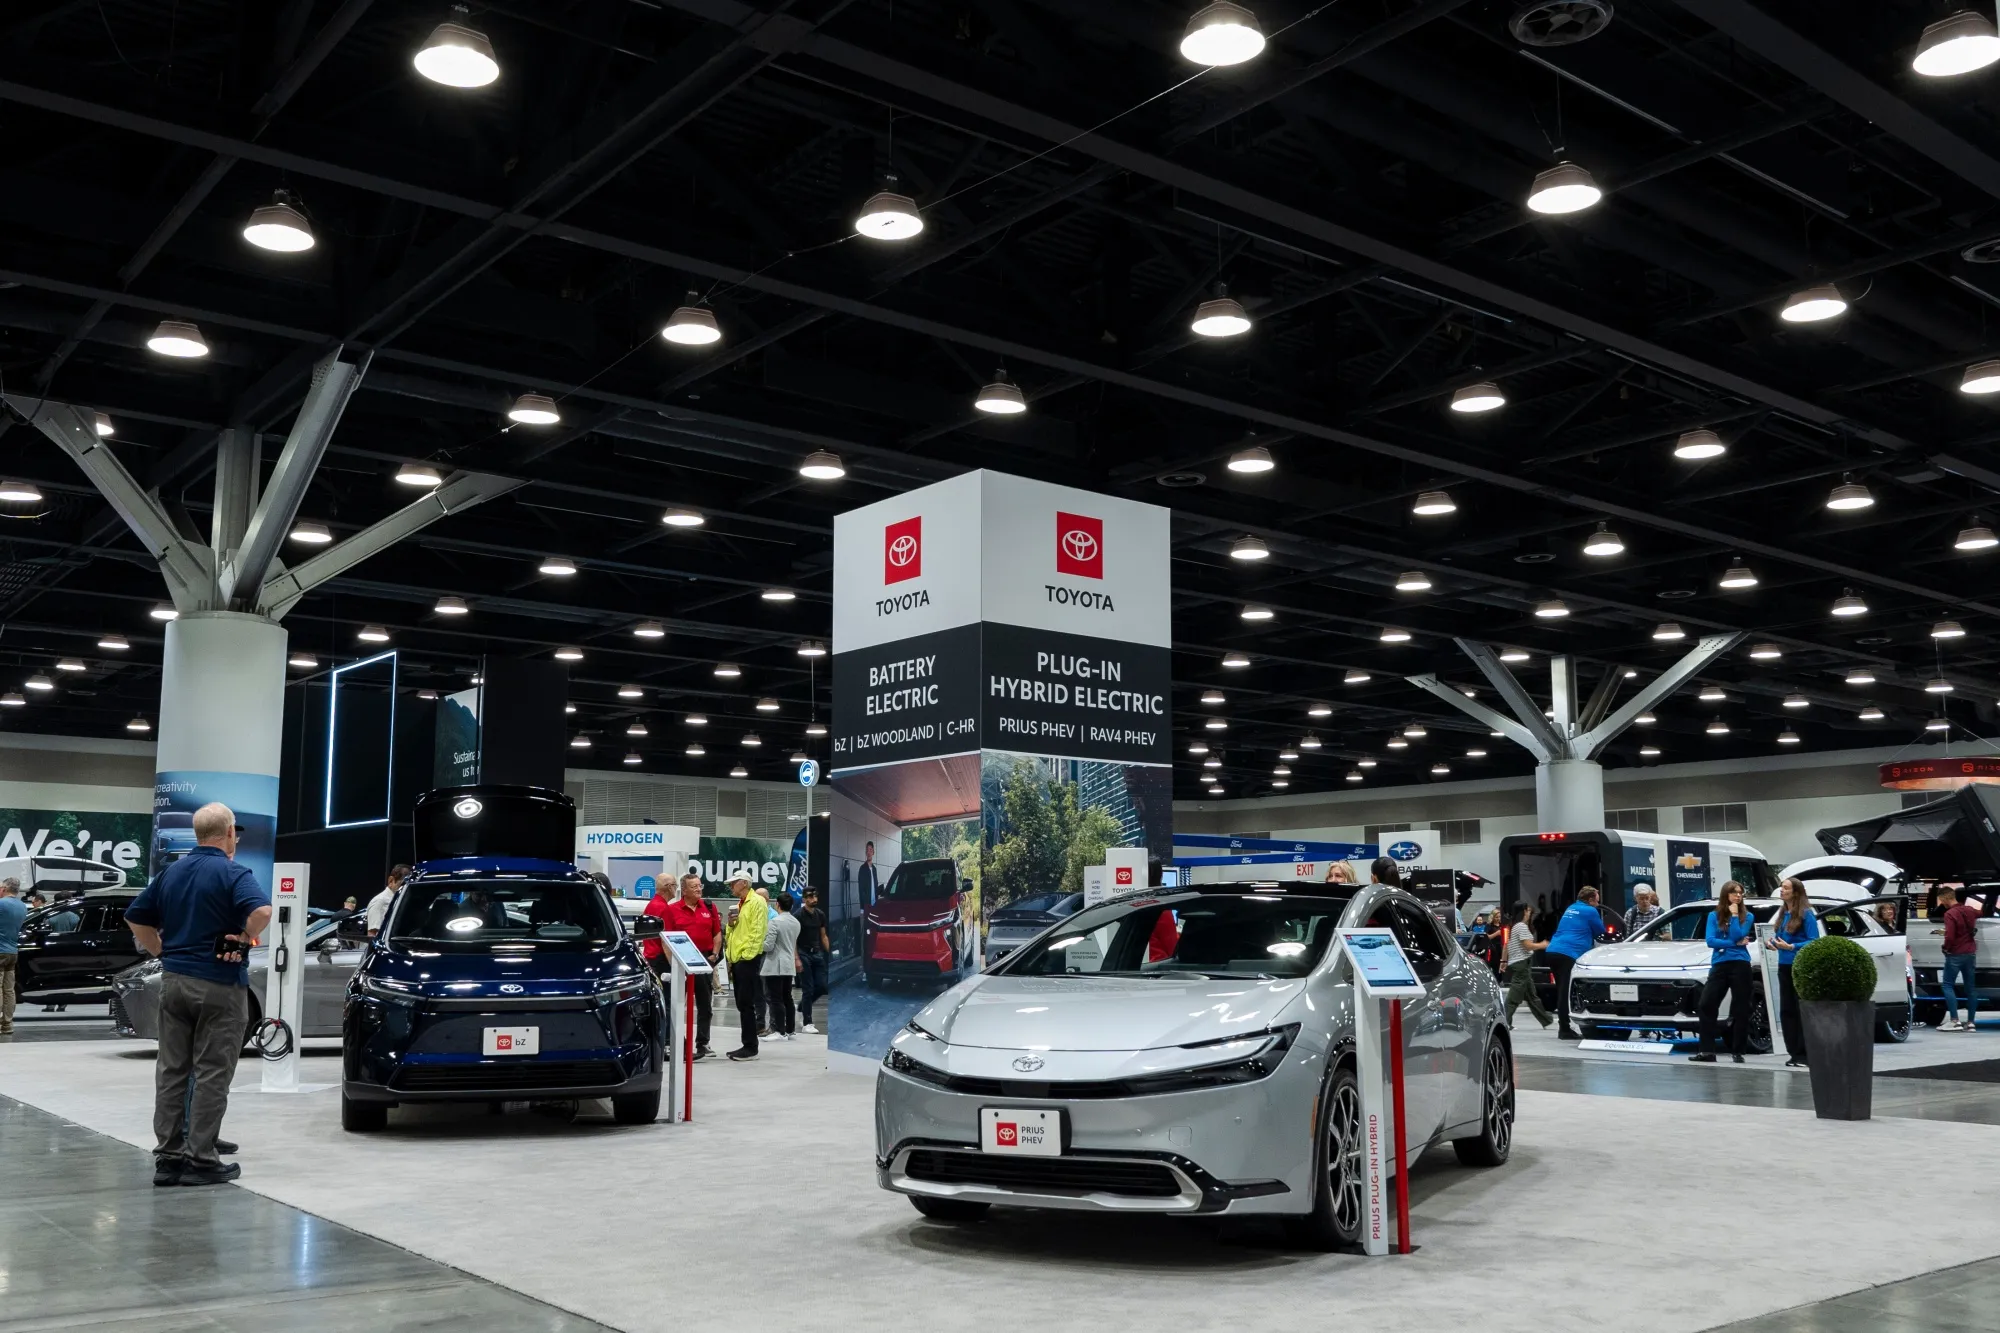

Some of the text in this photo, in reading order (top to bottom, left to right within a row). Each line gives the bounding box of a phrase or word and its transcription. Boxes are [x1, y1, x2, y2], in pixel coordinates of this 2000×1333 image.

[876, 589, 930, 617] TOYOTA
[1045, 585, 1114, 612] TOYOTA
[869, 655, 936, 687] BATTERY
[1037, 651, 1121, 682] PLUG-IN
[866, 684, 939, 716] ELECTRIC
[990, 675, 1163, 715] HYBRID ELECTRIC
[834, 737, 846, 752] bZ
[857, 734, 869, 748] bZ
[871, 724, 934, 746] WOODLAND
[946, 718, 975, 736] C-HR
[999, 717, 1038, 735] PRIUS
[1041, 721, 1075, 738] PHEV
[1090, 726, 1121, 743] RAV4
[1124, 730, 1156, 745] PHEV
[157, 781, 197, 795] creativity
[587, 832, 663, 844] HYDROGEN
[1230, 840, 1243, 848] Ford
[1294, 844, 1306, 852] Ford
[688, 859, 789, 892] ourney
[790, 854, 808, 897] Ford
[1296, 864, 1315, 876] EXIT
[1630, 865, 1646, 875] MADE
[1646, 866, 1653, 876] IN
[515, 1038, 526, 1046] bZ
[1021, 1126, 1045, 1134] PRIUS
[1021, 1136, 1043, 1144] PHEV
[1369, 1114, 1381, 1240] PRIUS PLUG-IN HYBRID
